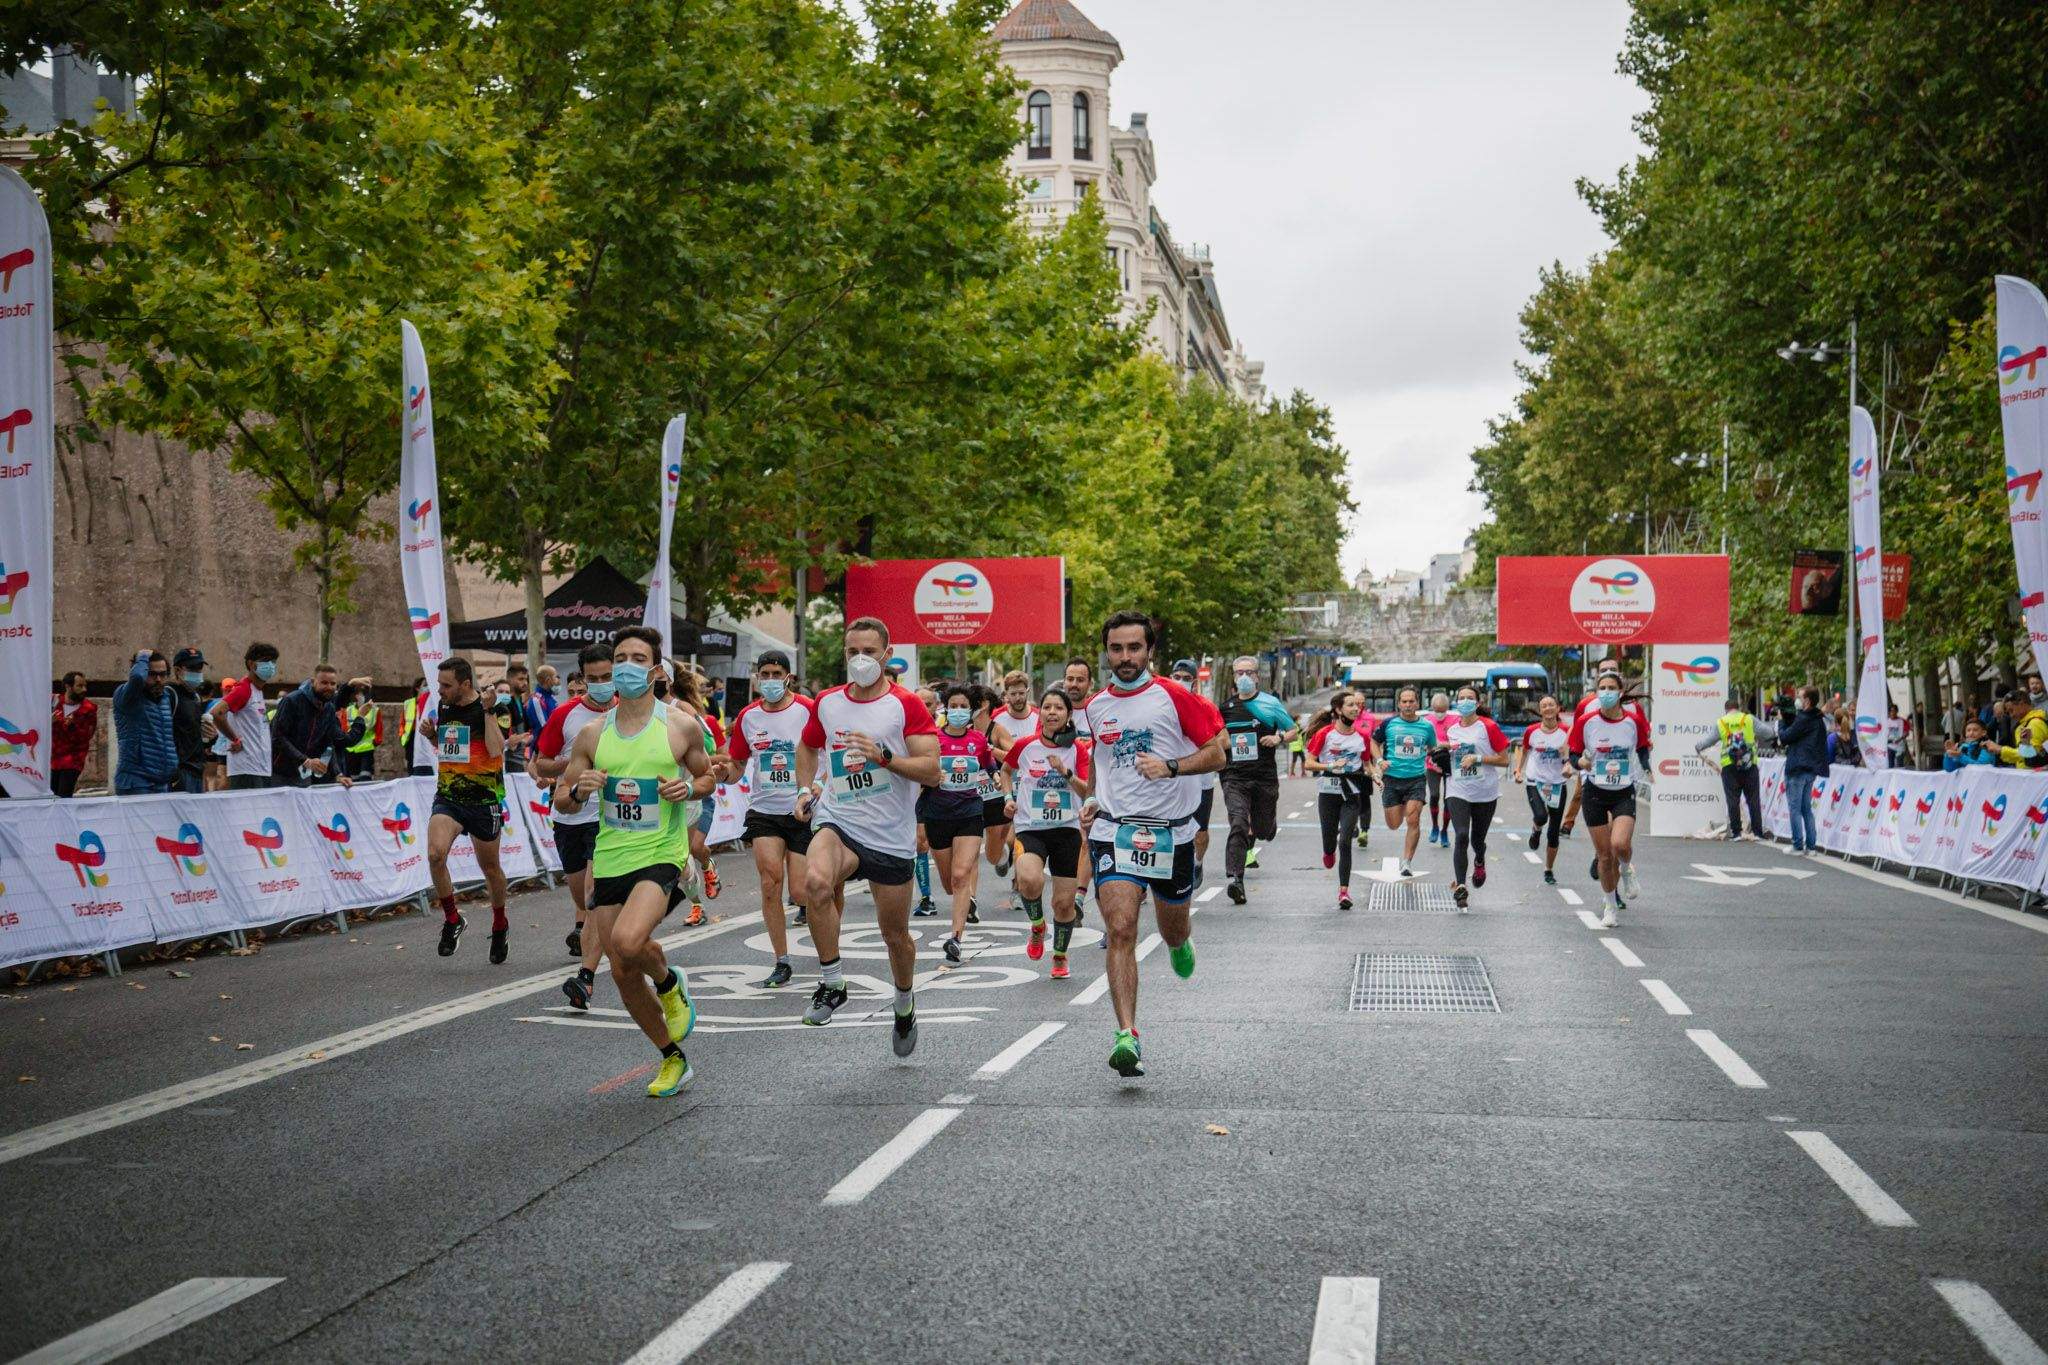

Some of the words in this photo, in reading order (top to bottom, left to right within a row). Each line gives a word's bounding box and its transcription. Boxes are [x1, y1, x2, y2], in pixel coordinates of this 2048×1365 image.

[544, 600, 643, 620] vedeport
[932, 600, 978, 608] TotalEnergies
[1661, 688, 1720, 699] TotalEnergies
[1673, 725, 1713, 734] MADRI
[769, 771, 790, 783] 489
[845, 771, 873, 791] 109
[950, 773, 969, 784] 493
[978, 783, 995, 796] 320
[614, 803, 642, 821] 183
[1043, 808, 1063, 821] 501
[1131, 850, 1157, 867] 491
